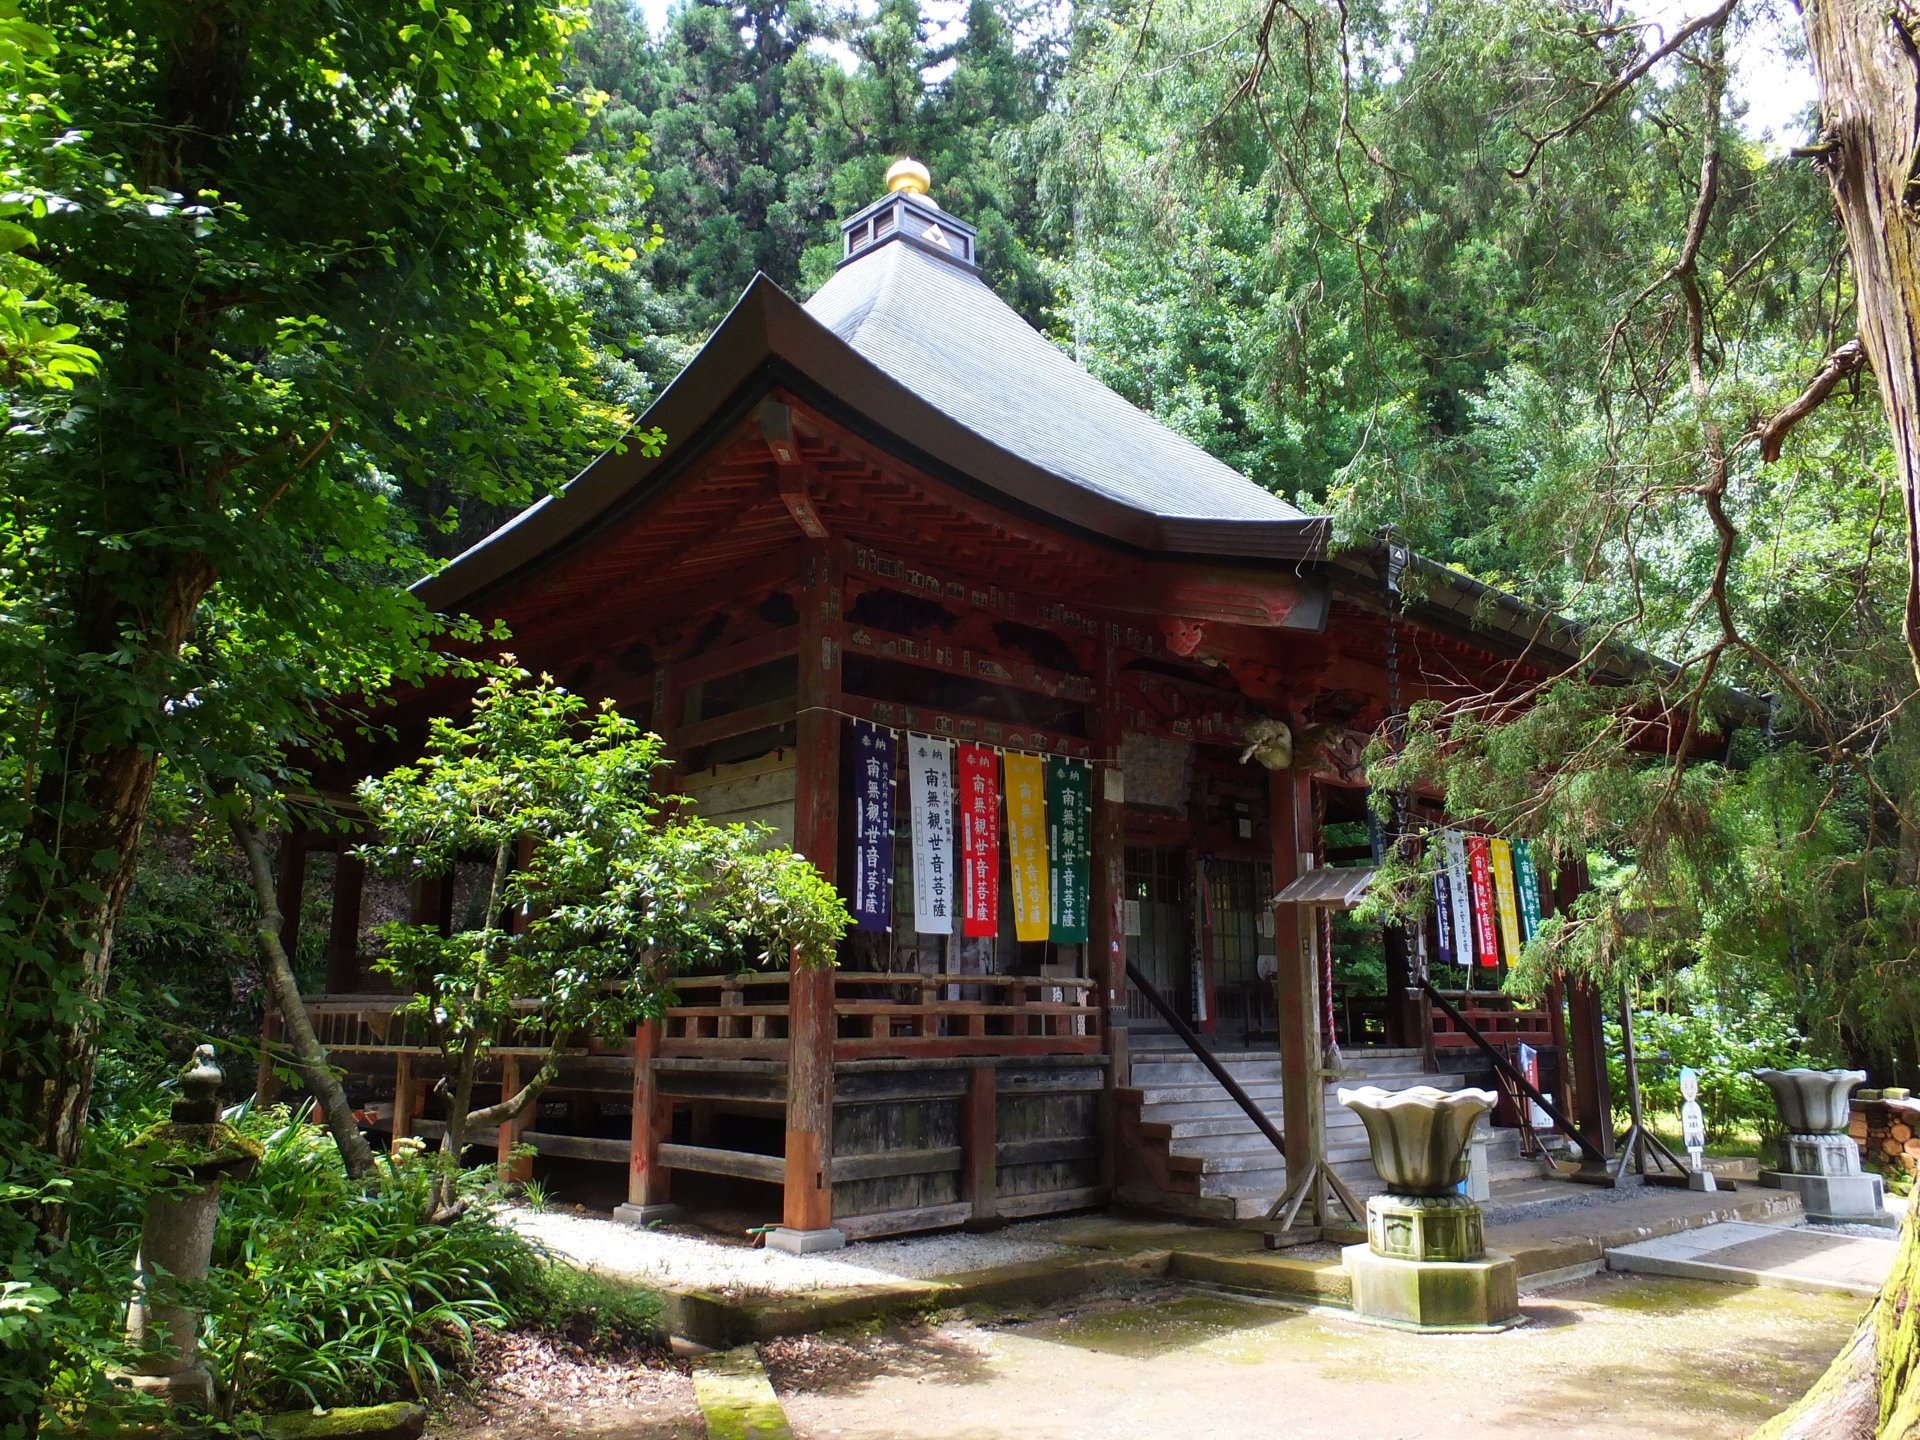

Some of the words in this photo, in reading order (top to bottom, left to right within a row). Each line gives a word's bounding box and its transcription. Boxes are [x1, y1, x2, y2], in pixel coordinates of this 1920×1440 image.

[861, 734, 886, 751] 奉納
[917, 746, 943, 760] 奉納
[966, 754, 990, 768] 奉納
[1056, 768, 1080, 782] 奉納
[865, 756, 881, 914] 南無観世音菩薩
[924, 767, 947, 918] 南無観世音菩薩
[972, 773, 989, 922] 南無観世音菩薩
[1061, 787, 1076, 928] 南無観世音菩薩
